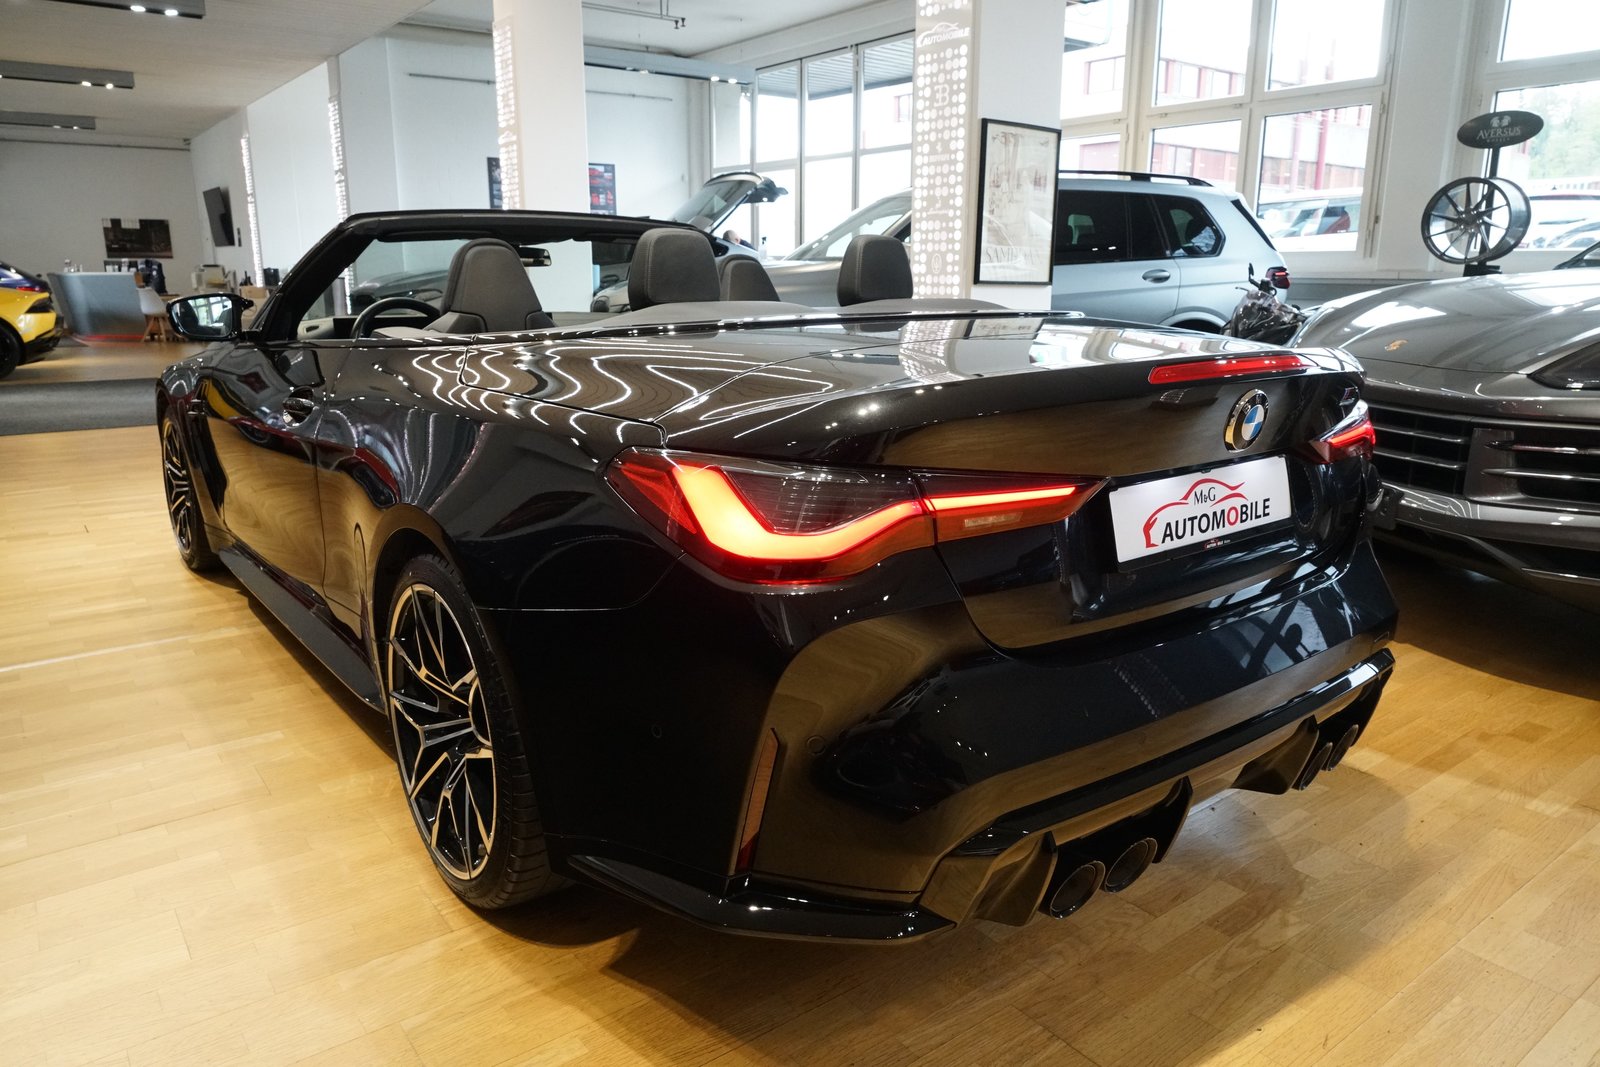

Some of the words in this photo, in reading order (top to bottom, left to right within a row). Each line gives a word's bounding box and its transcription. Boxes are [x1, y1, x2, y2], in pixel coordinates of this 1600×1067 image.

[1476, 126, 1522, 140] AVERSUS
[1193, 486, 1216, 506] M&G
[1161, 497, 1271, 544] AUTOMOBILE
